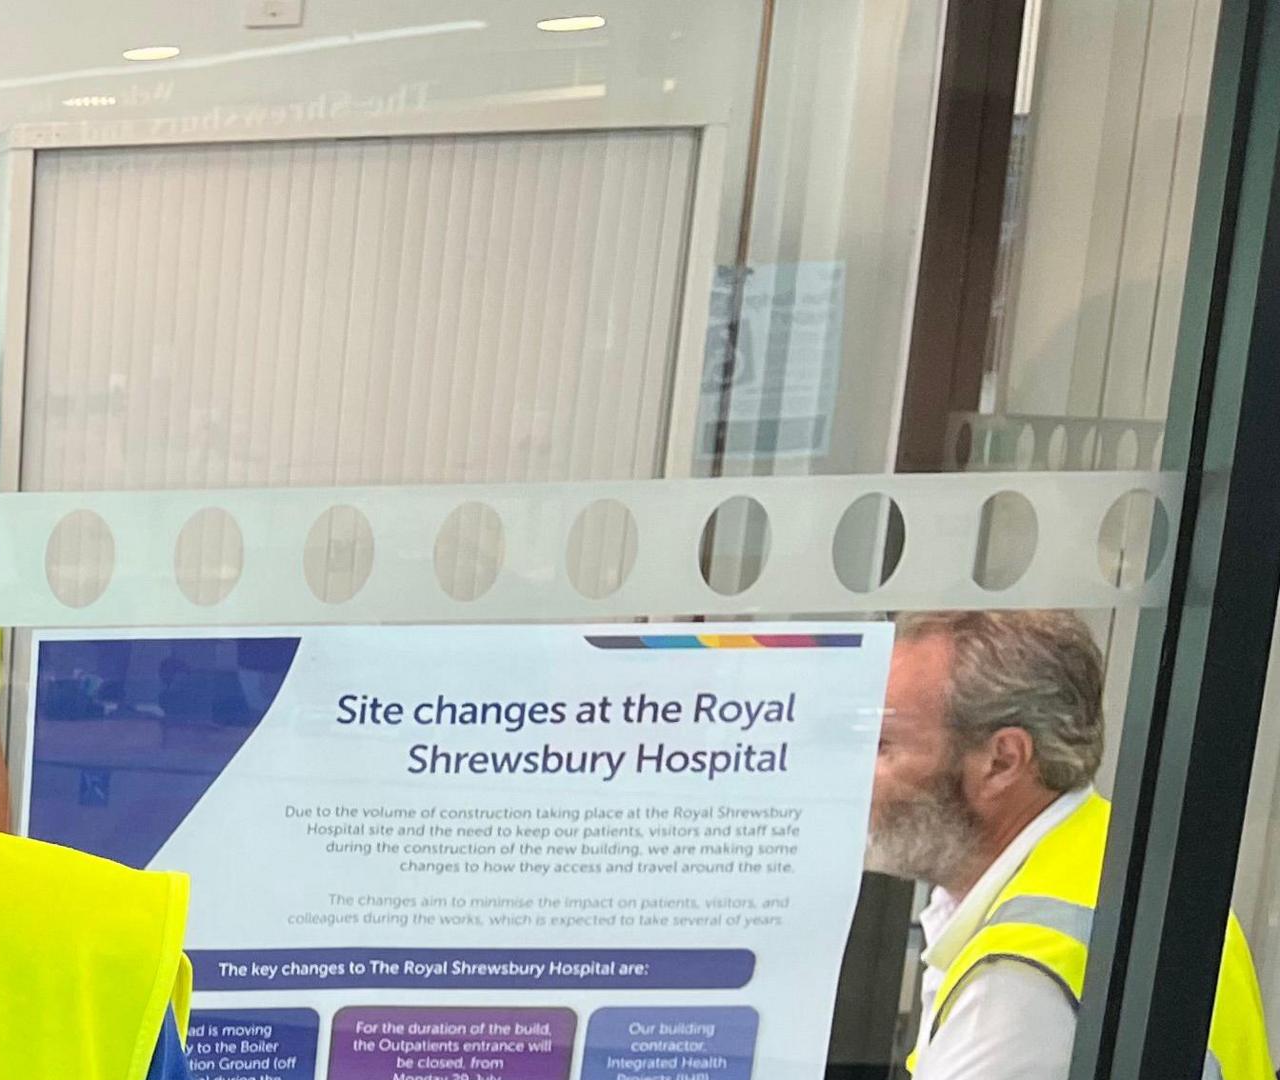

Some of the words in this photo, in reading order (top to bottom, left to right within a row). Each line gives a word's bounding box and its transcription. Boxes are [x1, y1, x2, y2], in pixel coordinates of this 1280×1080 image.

[336, 694, 404, 725] Site
[413, 694, 567, 733] changes
[576, 696, 612, 724] at
[622, 693, 682, 723] the
[693, 693, 795, 731] Royal
[407, 744, 626, 782] Shrewsbury
[636, 742, 787, 781] Hospital
[218, 962, 248, 977] The
[251, 962, 278, 979] key
[281, 961, 345, 978] changes
[349, 961, 366, 975] to
[369, 960, 399, 975] The
[404, 960, 447, 978] Royal
[451, 960, 545, 979] Shrewsbury
[549, 961, 615, 978] Hospital
[619, 964, 649, 975] are:
[356, 1021, 379, 1034] For
[382, 1022, 405, 1035] the
[408, 1022, 466, 1035] duration
[470, 1022, 485, 1035] of
[489, 1023, 511, 1035] the
[353, 1039, 375, 1051] the
[379, 1038, 459, 1054] Outpatients
[463, 1040, 524, 1052] entrance
[528, 1039, 552, 1052] will
